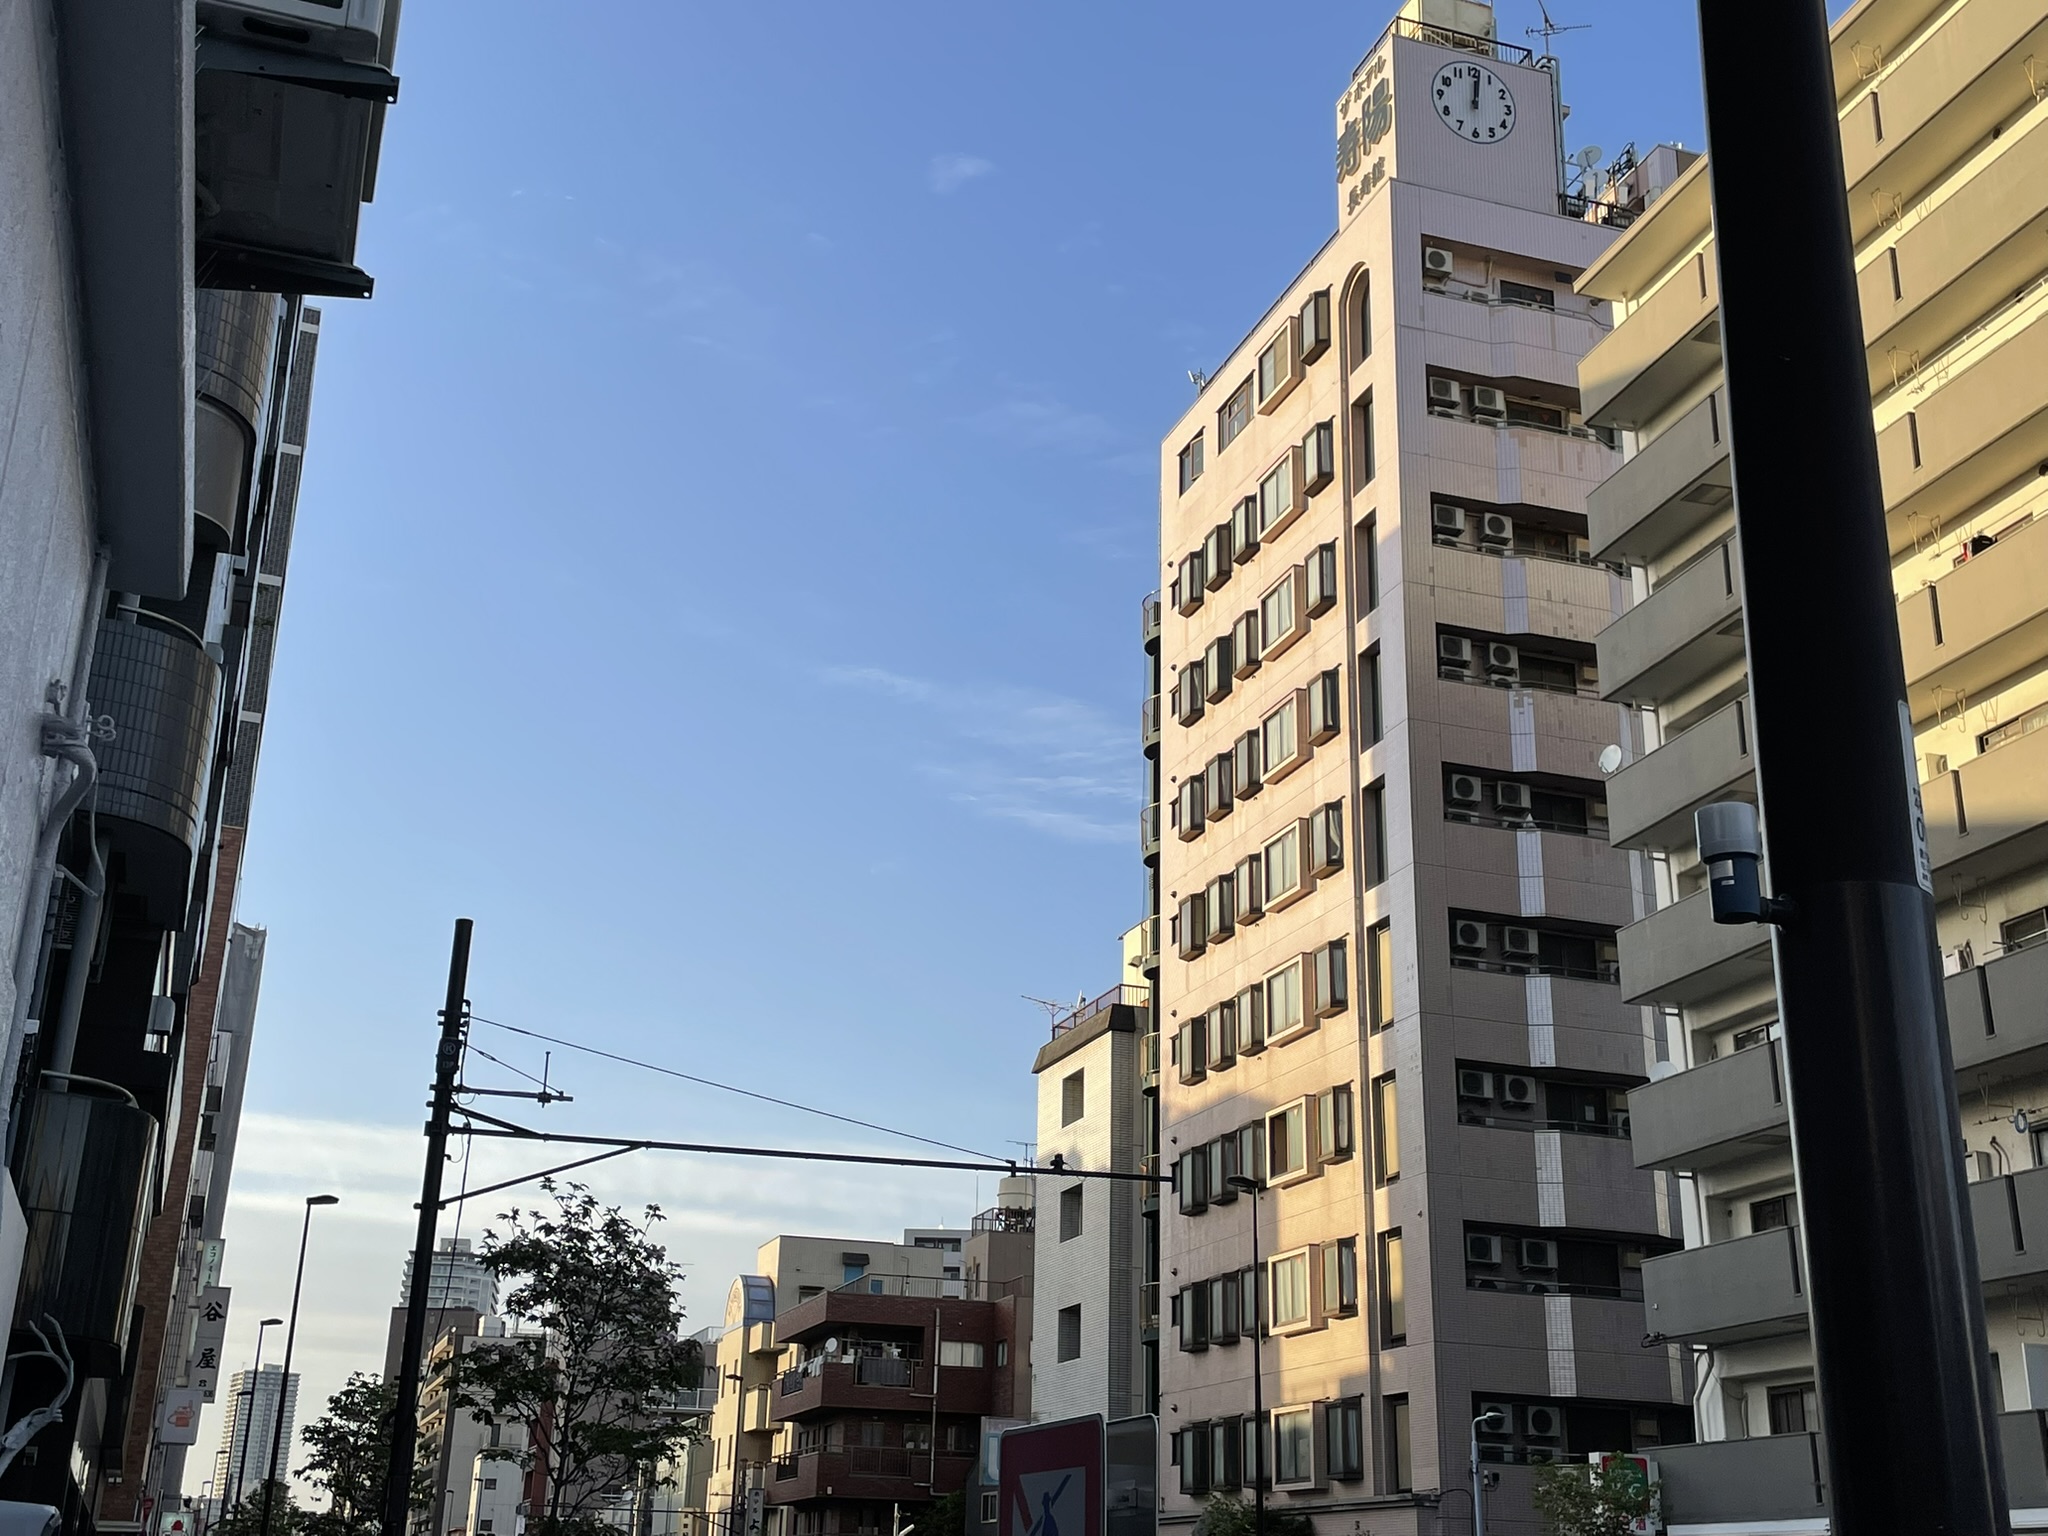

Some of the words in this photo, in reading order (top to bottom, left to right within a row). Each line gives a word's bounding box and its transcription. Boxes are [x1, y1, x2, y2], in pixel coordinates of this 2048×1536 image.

[1453, 66, 1462, 79] 11
[1467, 66, 1478, 79] 12
[1441, 75, 1452, 87] 10
[1436, 88, 1444, 101] 9
[1498, 88, 1506, 101] 2
[1442, 105, 1450, 117] 8
[1504, 104, 1512, 116] 3
[1456, 119, 1464, 131] 7
[1499, 118, 1508, 130] 4
[1471, 127, 1480, 139] 6
[1488, 127, 1495, 139] 5
[195, 1300, 226, 1370] 谷屋
